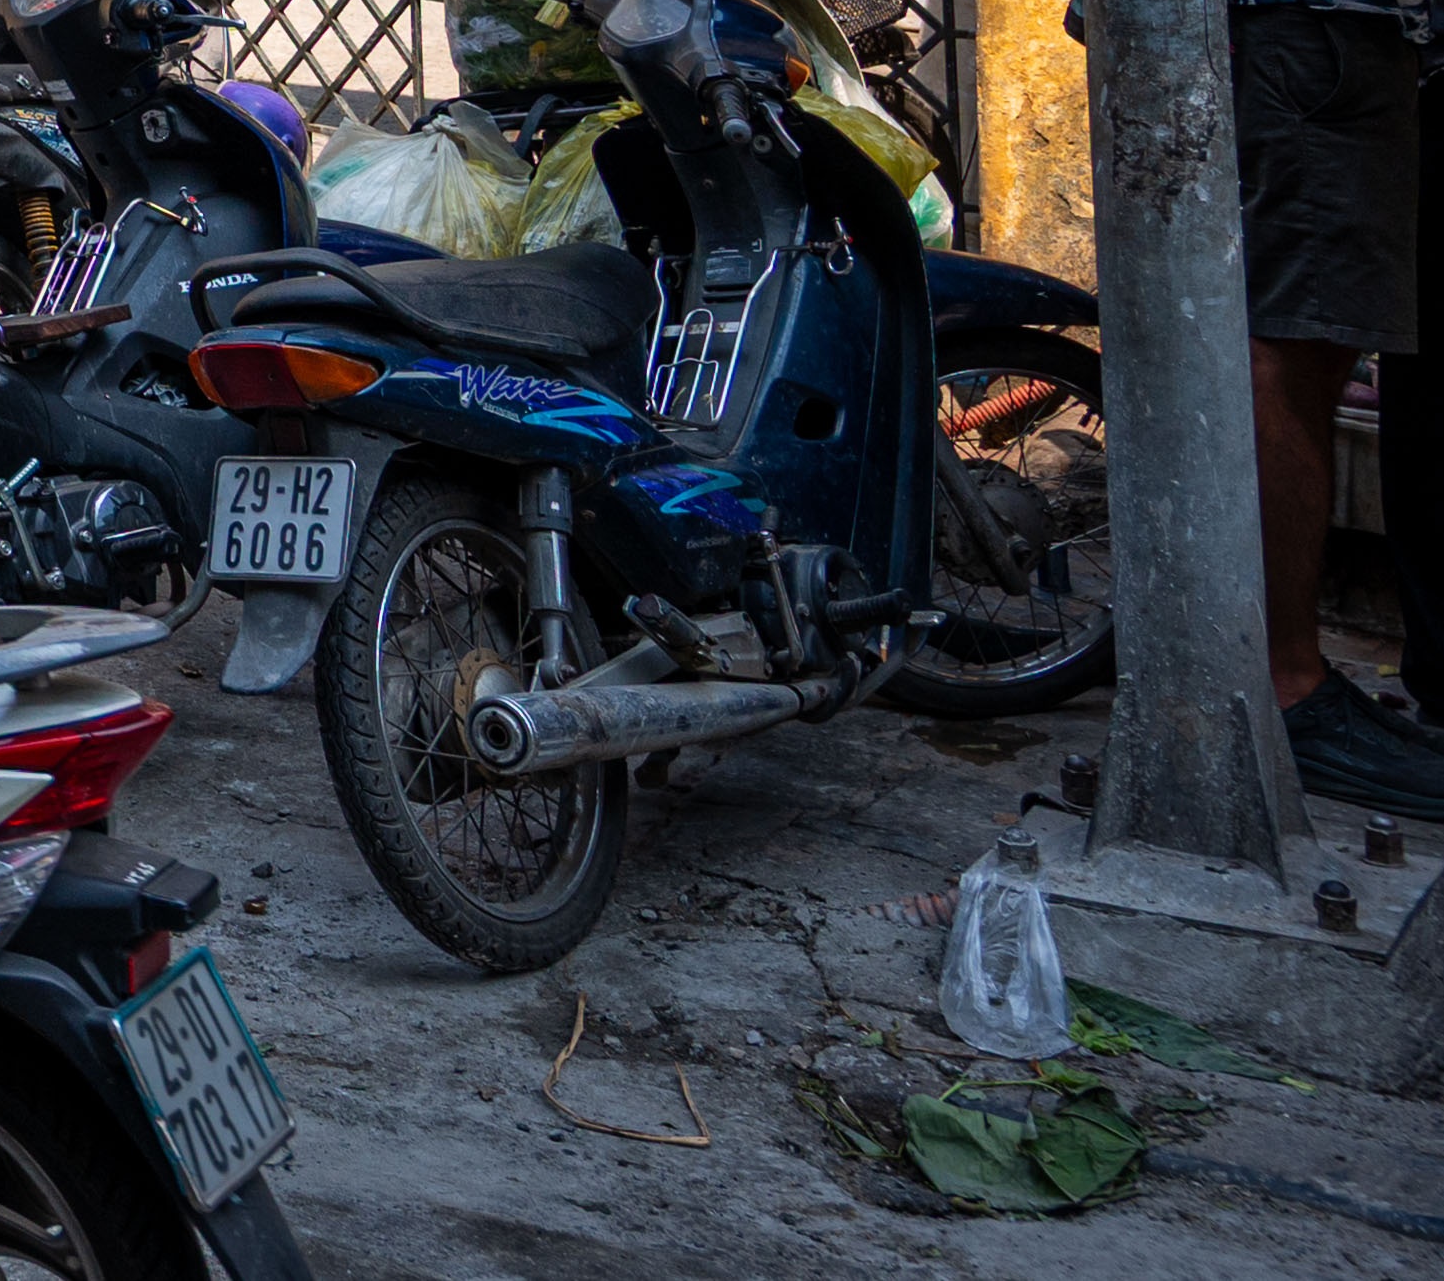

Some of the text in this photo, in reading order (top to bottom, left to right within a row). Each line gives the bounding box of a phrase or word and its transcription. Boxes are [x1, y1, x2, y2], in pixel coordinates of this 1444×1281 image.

[178, 272, 258, 293] HNDA
[454, 363, 584, 409] Wave
[229, 466, 335, 517] 29-H2
[224, 521, 327, 572] 6086
[169, 1050, 275, 1192] 703.17
